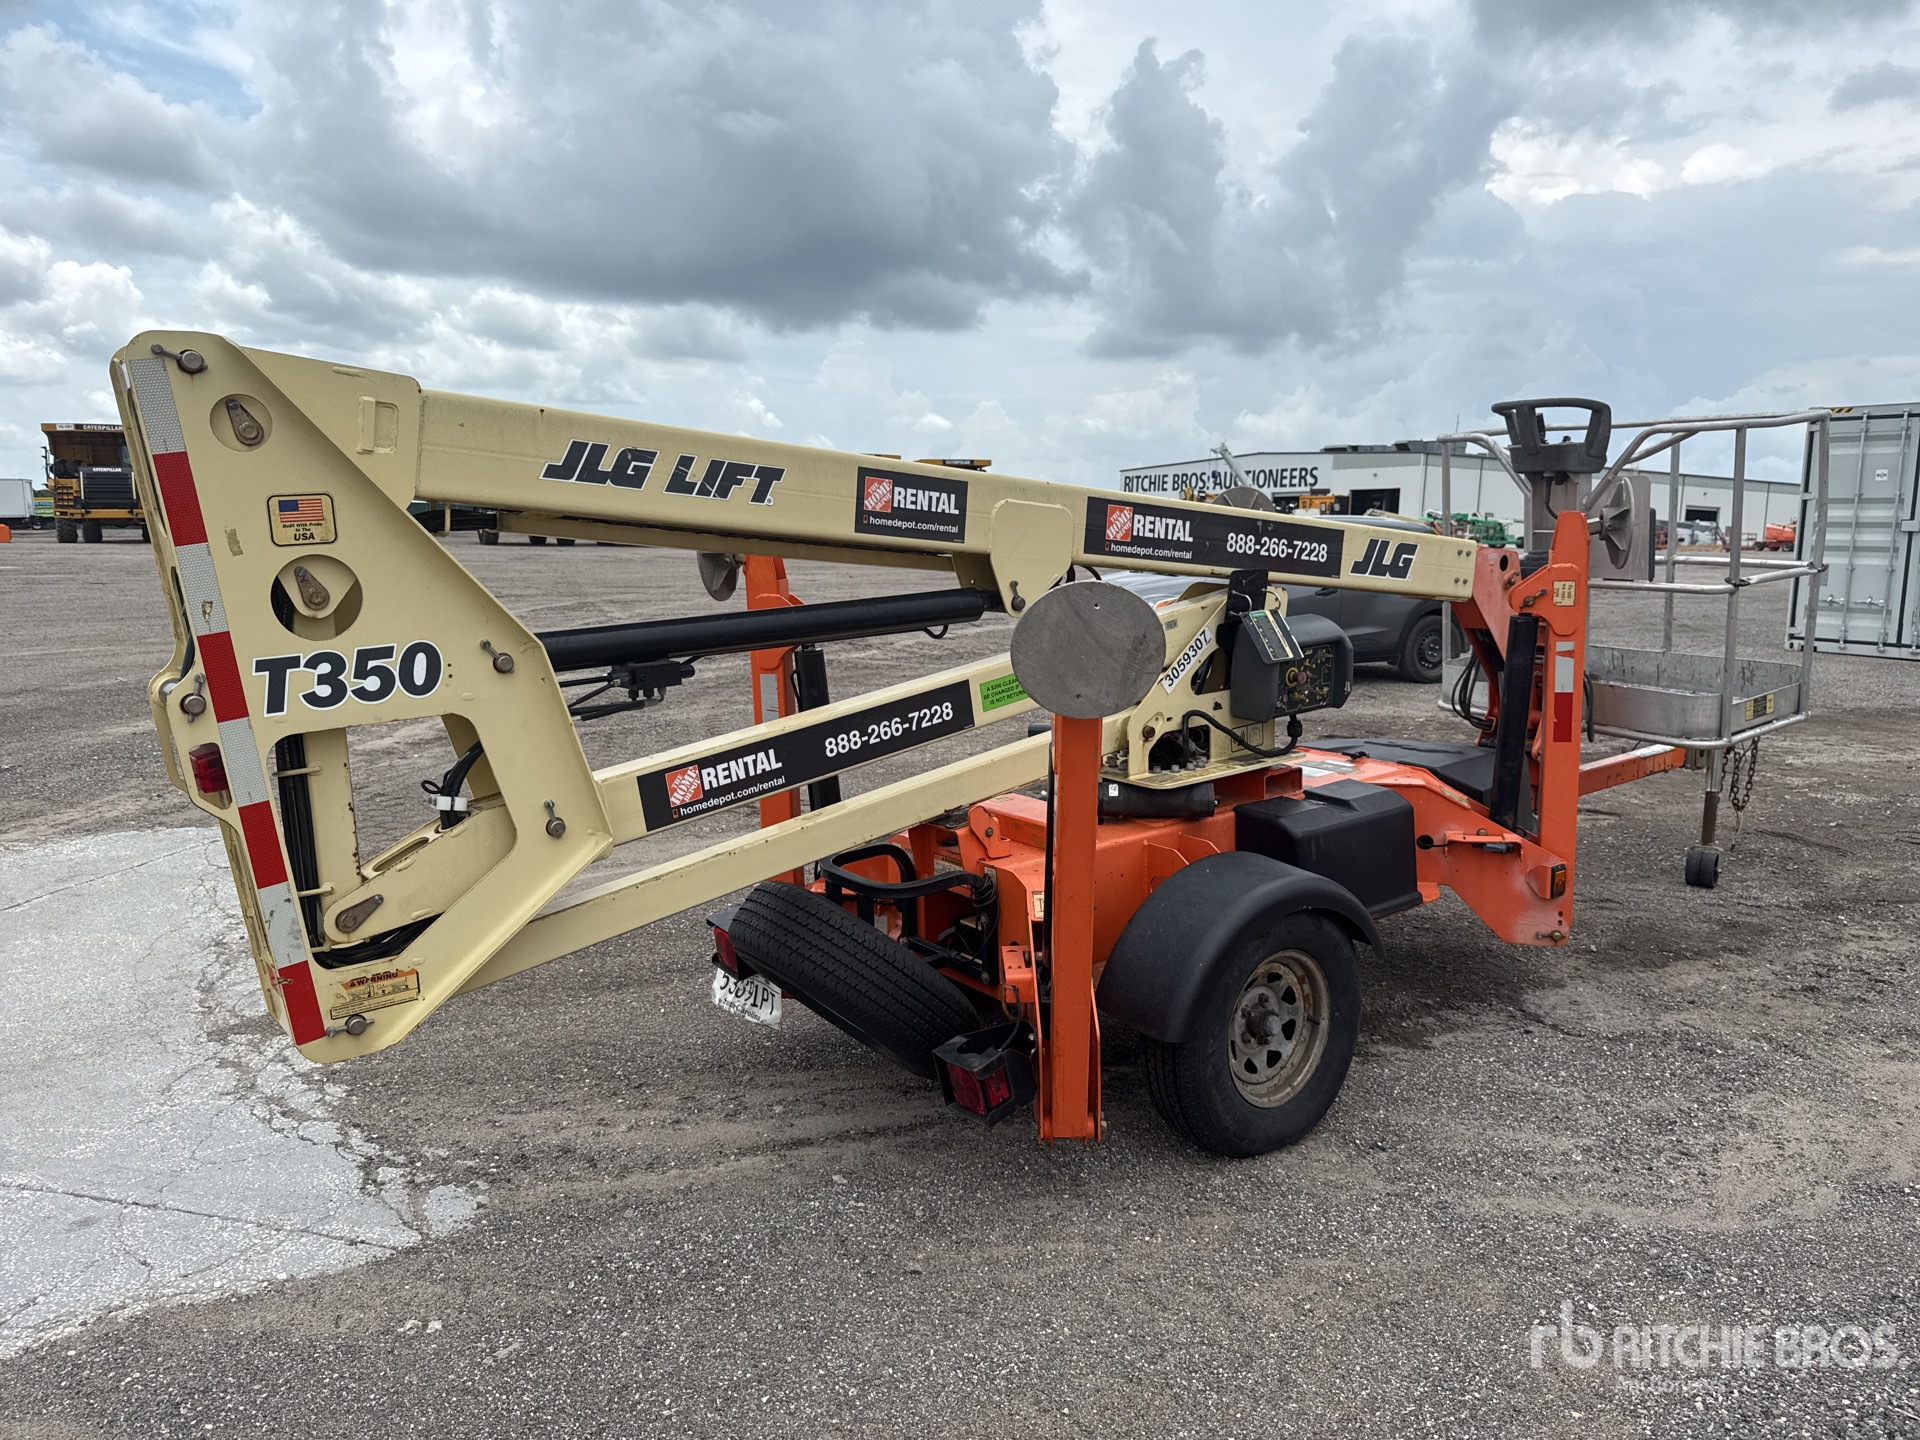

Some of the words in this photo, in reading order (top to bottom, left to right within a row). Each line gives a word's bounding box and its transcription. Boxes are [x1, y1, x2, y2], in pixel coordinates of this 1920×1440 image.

[539, 439, 660, 490] JLG
[663, 454, 788, 505] LIFT
[868, 481, 880, 494] THE
[1124, 474, 1169, 492] RITCHIE
[864, 480, 892, 510] HOME
[875, 493, 892, 511] DEPOT
[893, 486, 960, 515] RENTAL
[869, 516, 959, 534] homedepot.com/rental
[1106, 507, 1133, 539] HOME
[1110, 509, 1122, 523] THE
[293, 532, 316, 541] USA
[1116, 522, 1132, 540] DEPOT
[1133, 514, 1194, 542] RENTAL
[1226, 532, 1328, 563] 888-266-7228
[1110, 543, 1193, 560] homedepot.com/rental
[1349, 538, 1420, 580] JLG
[1165, 629, 1212, 687] 3059307
[252, 639, 444, 717] T350
[991, 685, 1014, 697] CHARGED
[996, 695, 1006, 703] NOT
[701, 749, 782, 791] RENTAL
[824, 701, 953, 757] 888-266-7228
[670, 766, 699, 806] HOME
[671, 773, 684, 788] THE
[683, 778, 701, 803] DEPOT
[680, 776, 786, 816] homedepot.com/rental
[357, 972, 399, 986] WARNING
